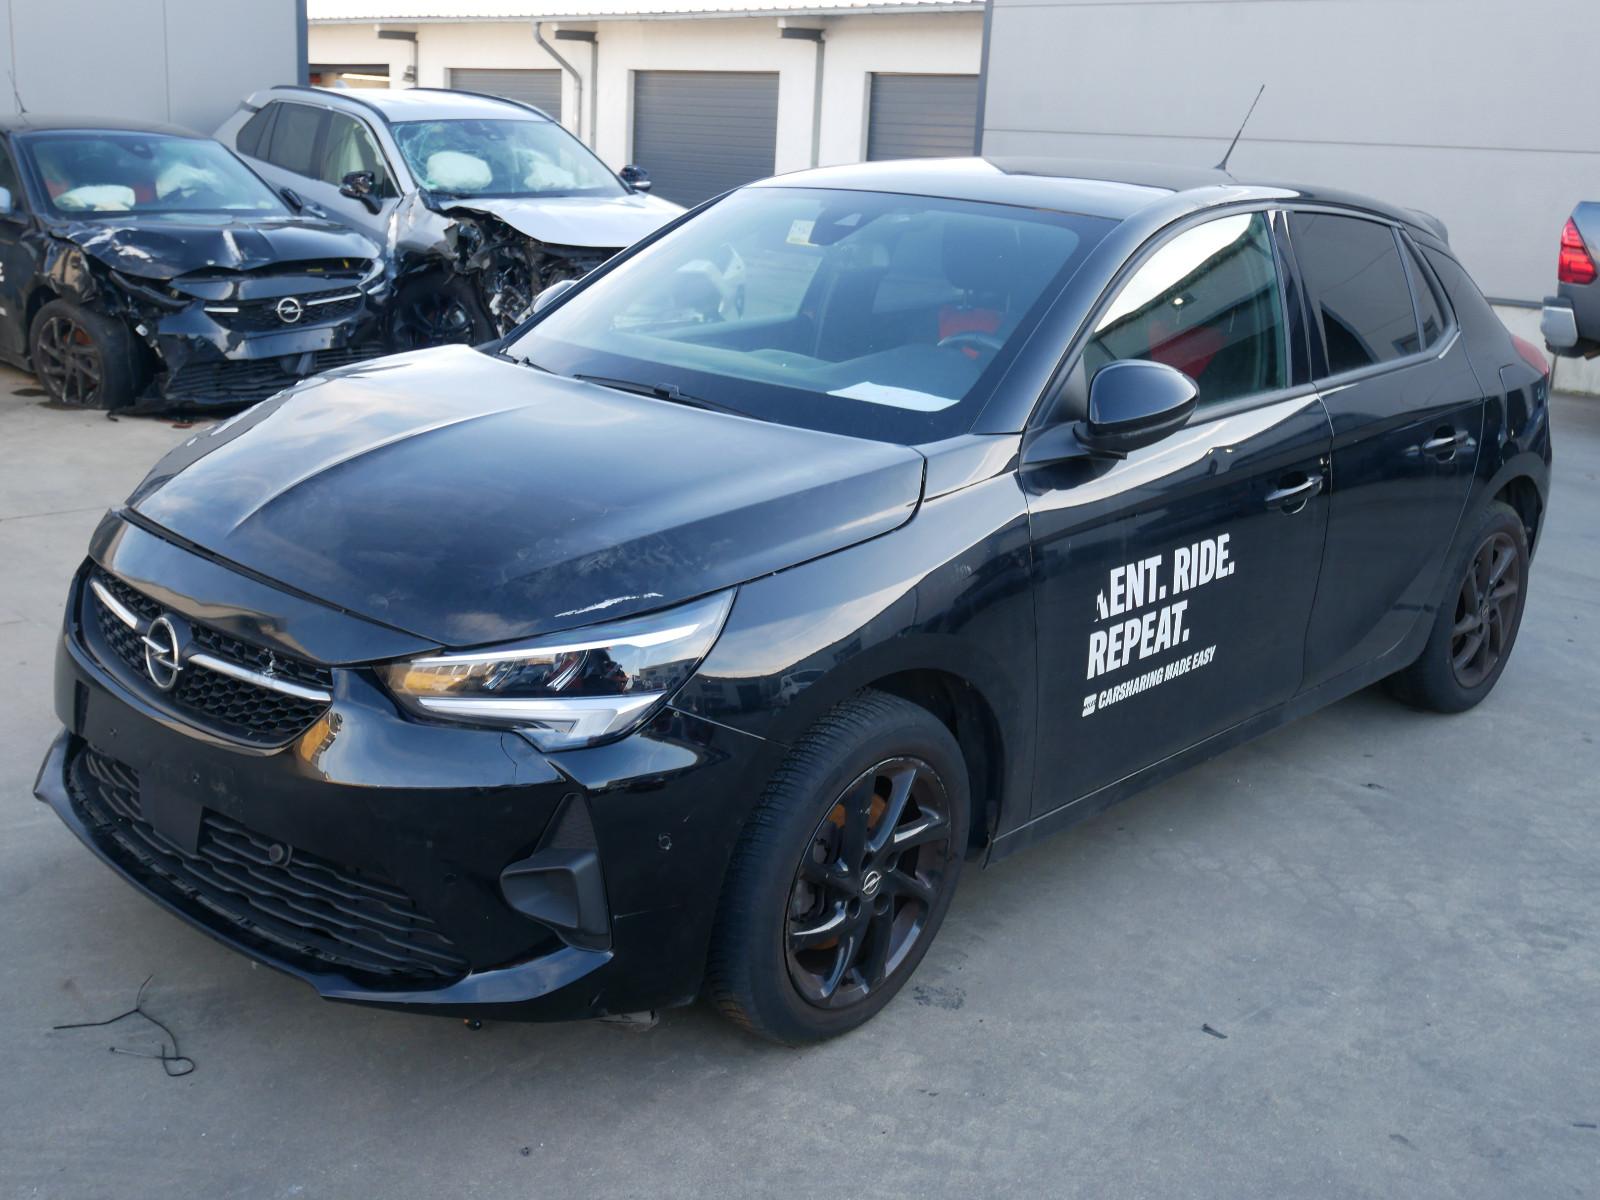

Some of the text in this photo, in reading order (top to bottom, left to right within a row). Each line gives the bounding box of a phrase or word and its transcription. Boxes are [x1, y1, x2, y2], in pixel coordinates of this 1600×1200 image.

[1173, 533, 1235, 595] RIDE.
[1086, 599, 1190, 680] REPEAT.
[1098, 667, 1164, 709] CARSHARING
[1164, 658, 1192, 682] MADE
[1191, 645, 1217, 670] EASY
